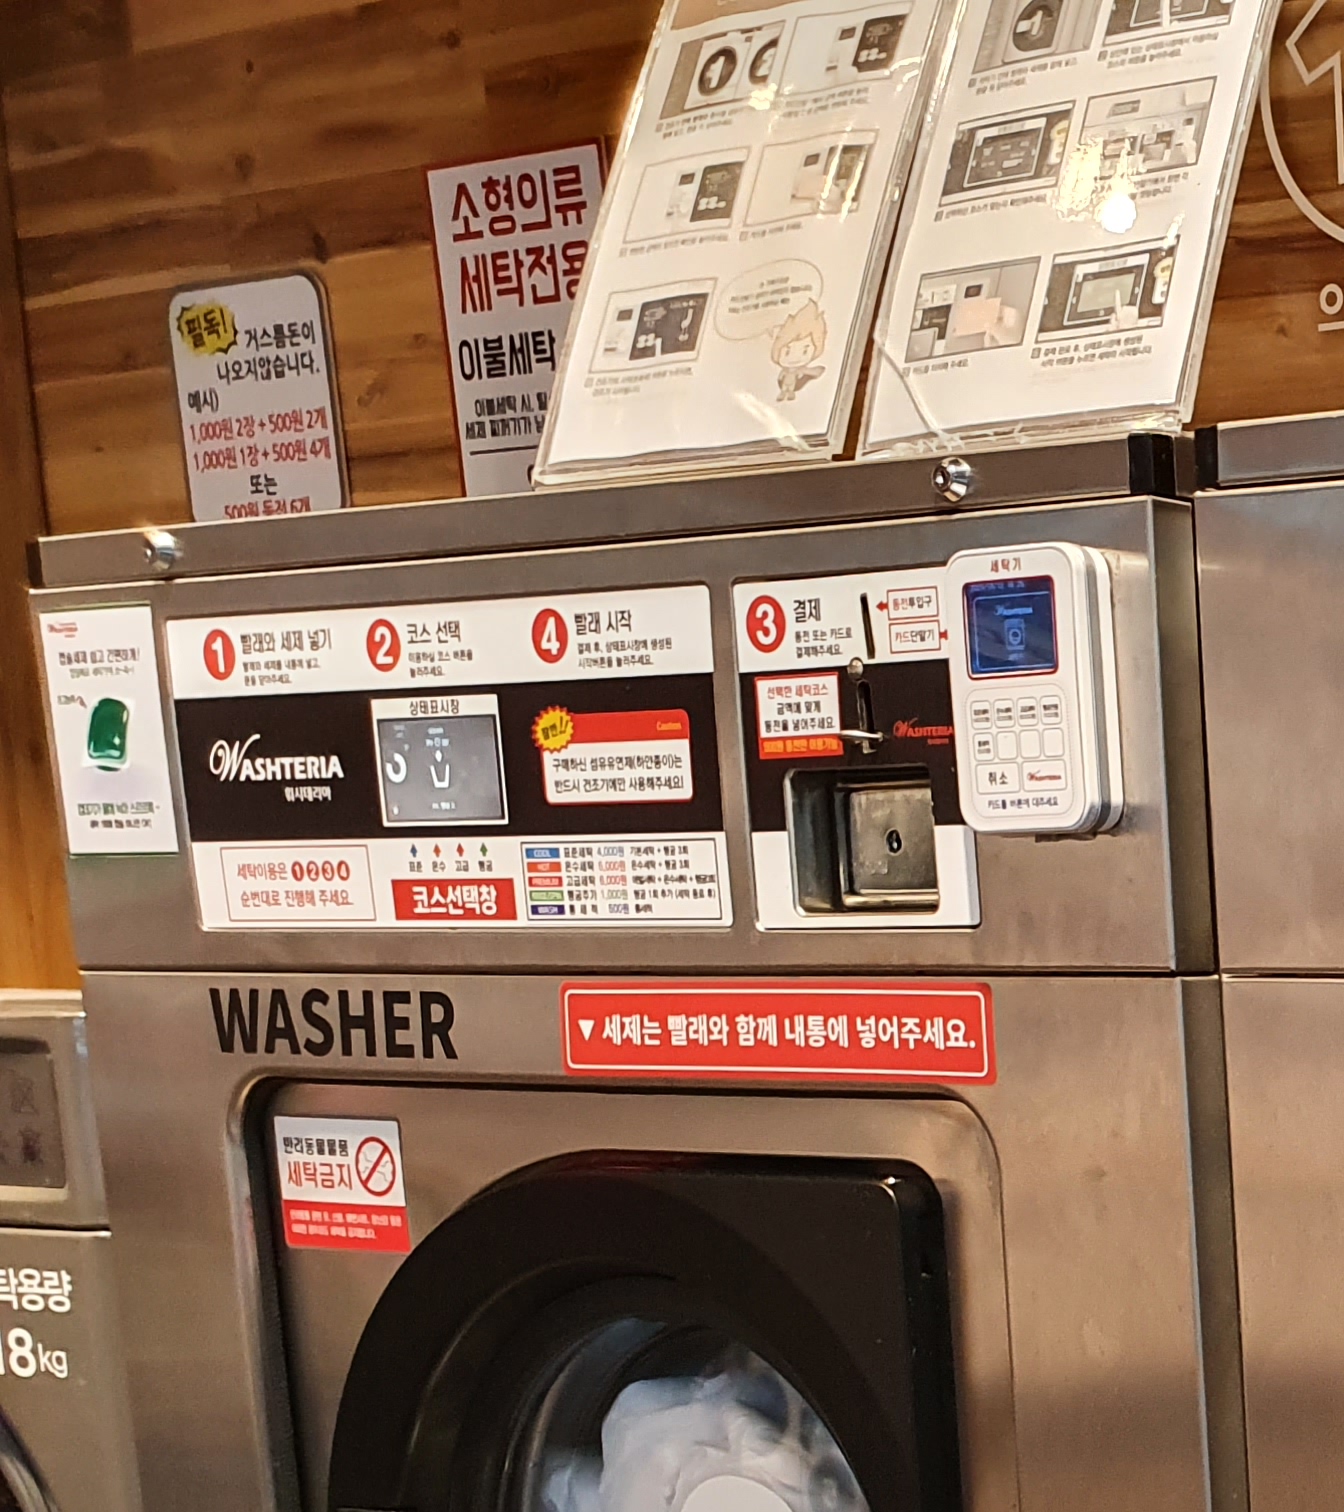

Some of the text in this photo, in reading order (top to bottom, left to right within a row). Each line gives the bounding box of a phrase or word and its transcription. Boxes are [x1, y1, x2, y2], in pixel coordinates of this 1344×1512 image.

[451, 165, 587, 242] 소형의류
[461, 240, 589, 314] 세탁전용
[244, 320, 316, 351] 거스름돈이
[459, 330, 556, 380] 이불세탁
[190, 410, 304, 444] 1,000원 500원
[193, 439, 307, 472] 1,000원 500원
[250, 474, 278, 495] 또는
[574, 610, 632, 636] 빨래 시작
[793, 598, 821, 623] 결제
[281, 631, 303, 651] 세제
[406, 621, 461, 644] 코스 선택
[209, 734, 344, 782] WASHTERIA
[412, 884, 498, 915] 코스선택창
[210, 986, 459, 1061] WASHER
[601, 1014, 976, 1051] 세제는 빨래와 함께 내통에 넣어주세요.
[288, 1161, 352, 1190] 세탁금지
